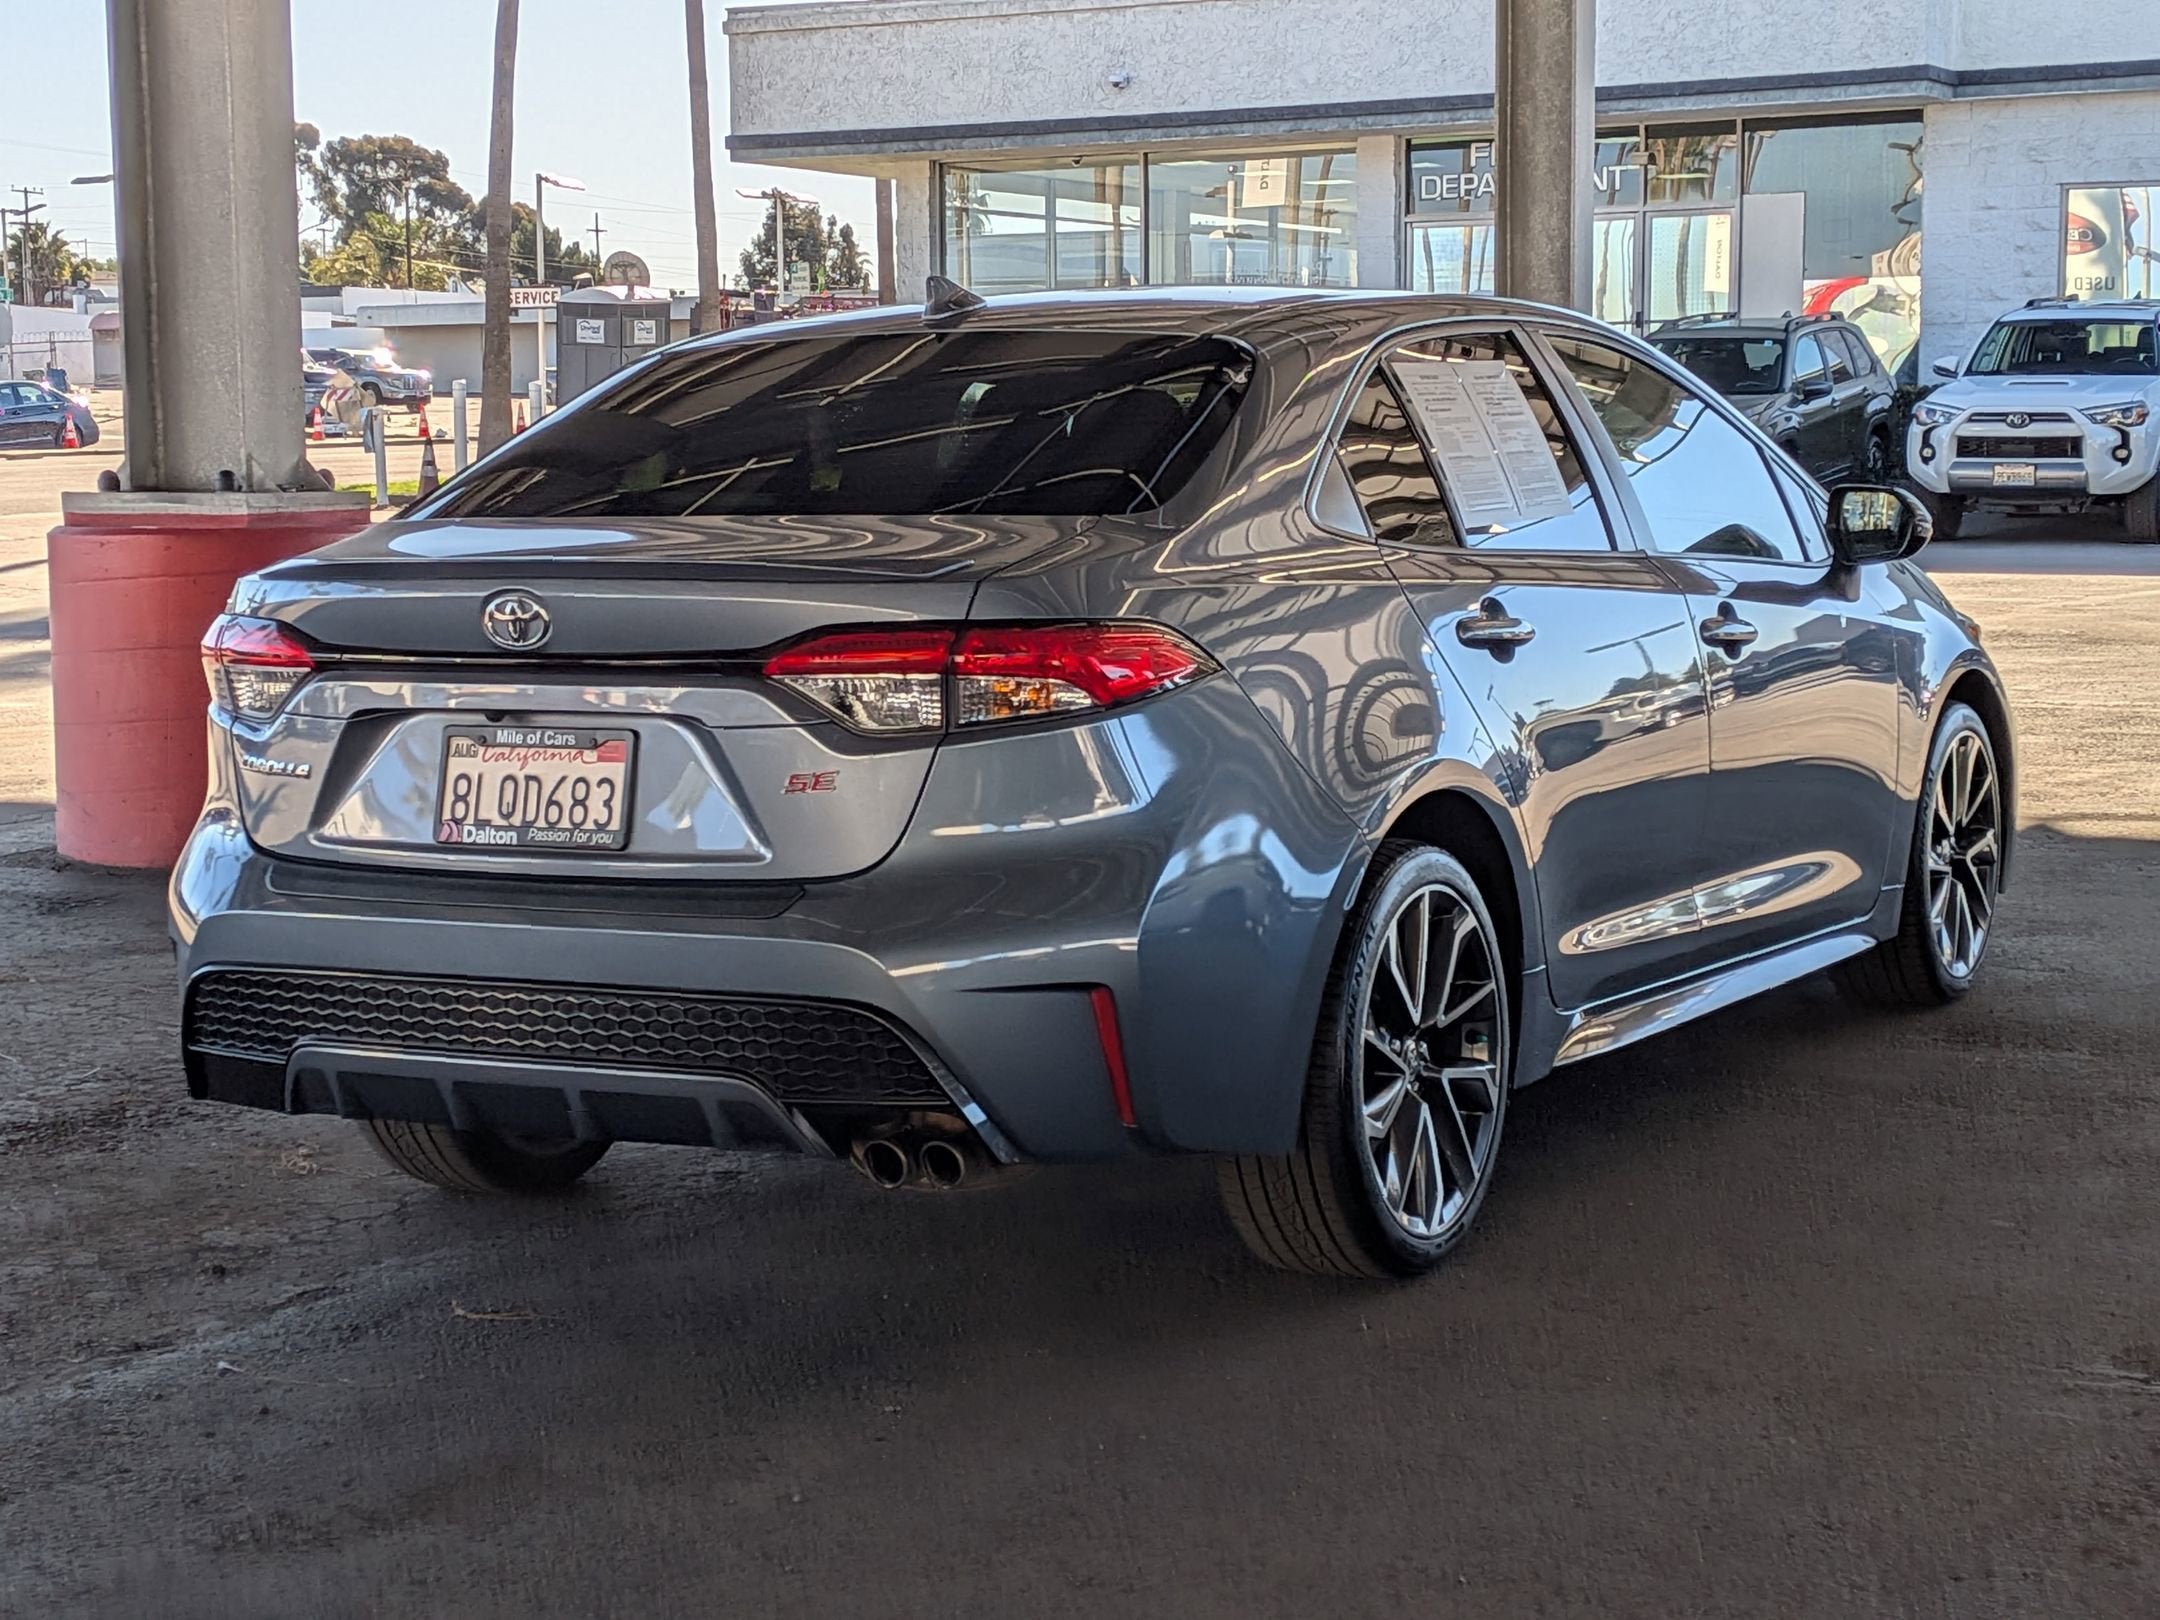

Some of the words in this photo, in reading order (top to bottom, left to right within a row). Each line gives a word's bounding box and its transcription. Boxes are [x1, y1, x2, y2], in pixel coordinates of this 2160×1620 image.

[1421, 165, 1627, 200] DEPANT
[496, 729, 523, 744] Mile
[527, 731, 541, 744] of
[544, 731, 576, 746] Cars
[450, 743, 479, 758] AUG
[481, 746, 597, 770] California
[781, 770, 840, 795] SE
[450, 773, 615, 829] 8LQD683
[463, 825, 518, 845] Dalton
[528, 828, 570, 842] Passion
[572, 829, 590, 842] for
[590, 832, 614, 846] you
